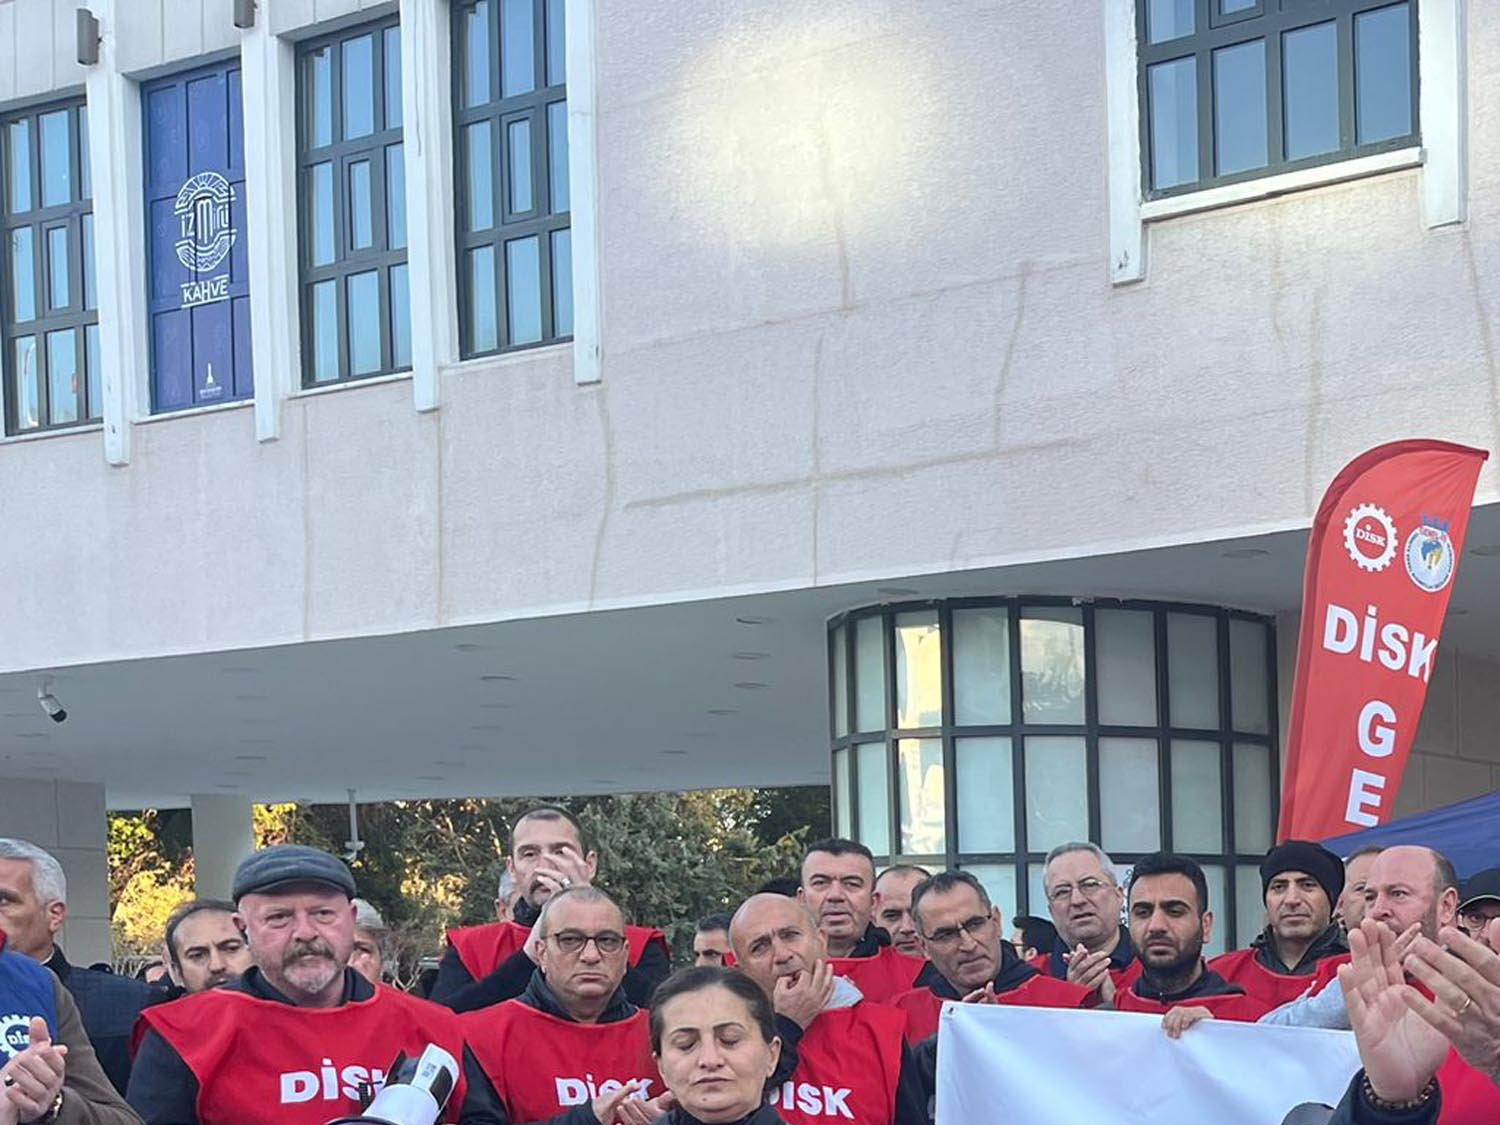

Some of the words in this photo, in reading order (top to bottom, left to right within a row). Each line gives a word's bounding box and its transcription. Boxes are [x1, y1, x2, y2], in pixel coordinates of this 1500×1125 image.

[183, 277, 229, 303] KAHVE
[1356, 524, 1386, 547] DİSK
[1323, 604, 1438, 683] DİSK
